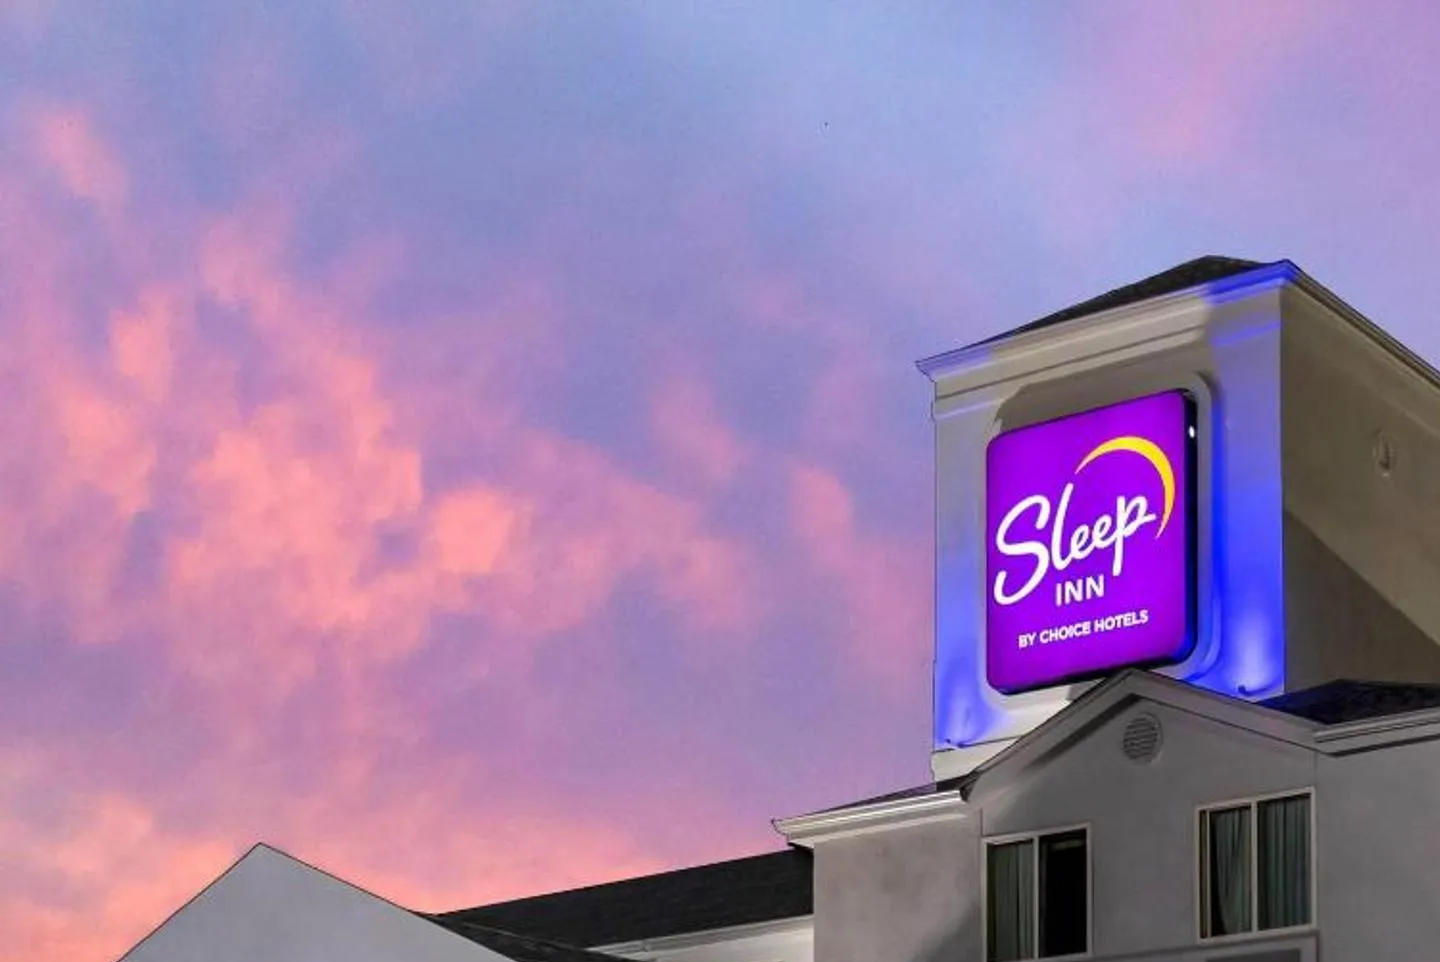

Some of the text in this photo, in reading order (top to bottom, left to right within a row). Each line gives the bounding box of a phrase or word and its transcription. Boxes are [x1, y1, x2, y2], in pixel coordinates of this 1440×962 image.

[994, 483, 1157, 606] Sleep
[1055, 574, 1105, 606] INN
[1018, 609, 1149, 649] BY CHOICE HOTELS
